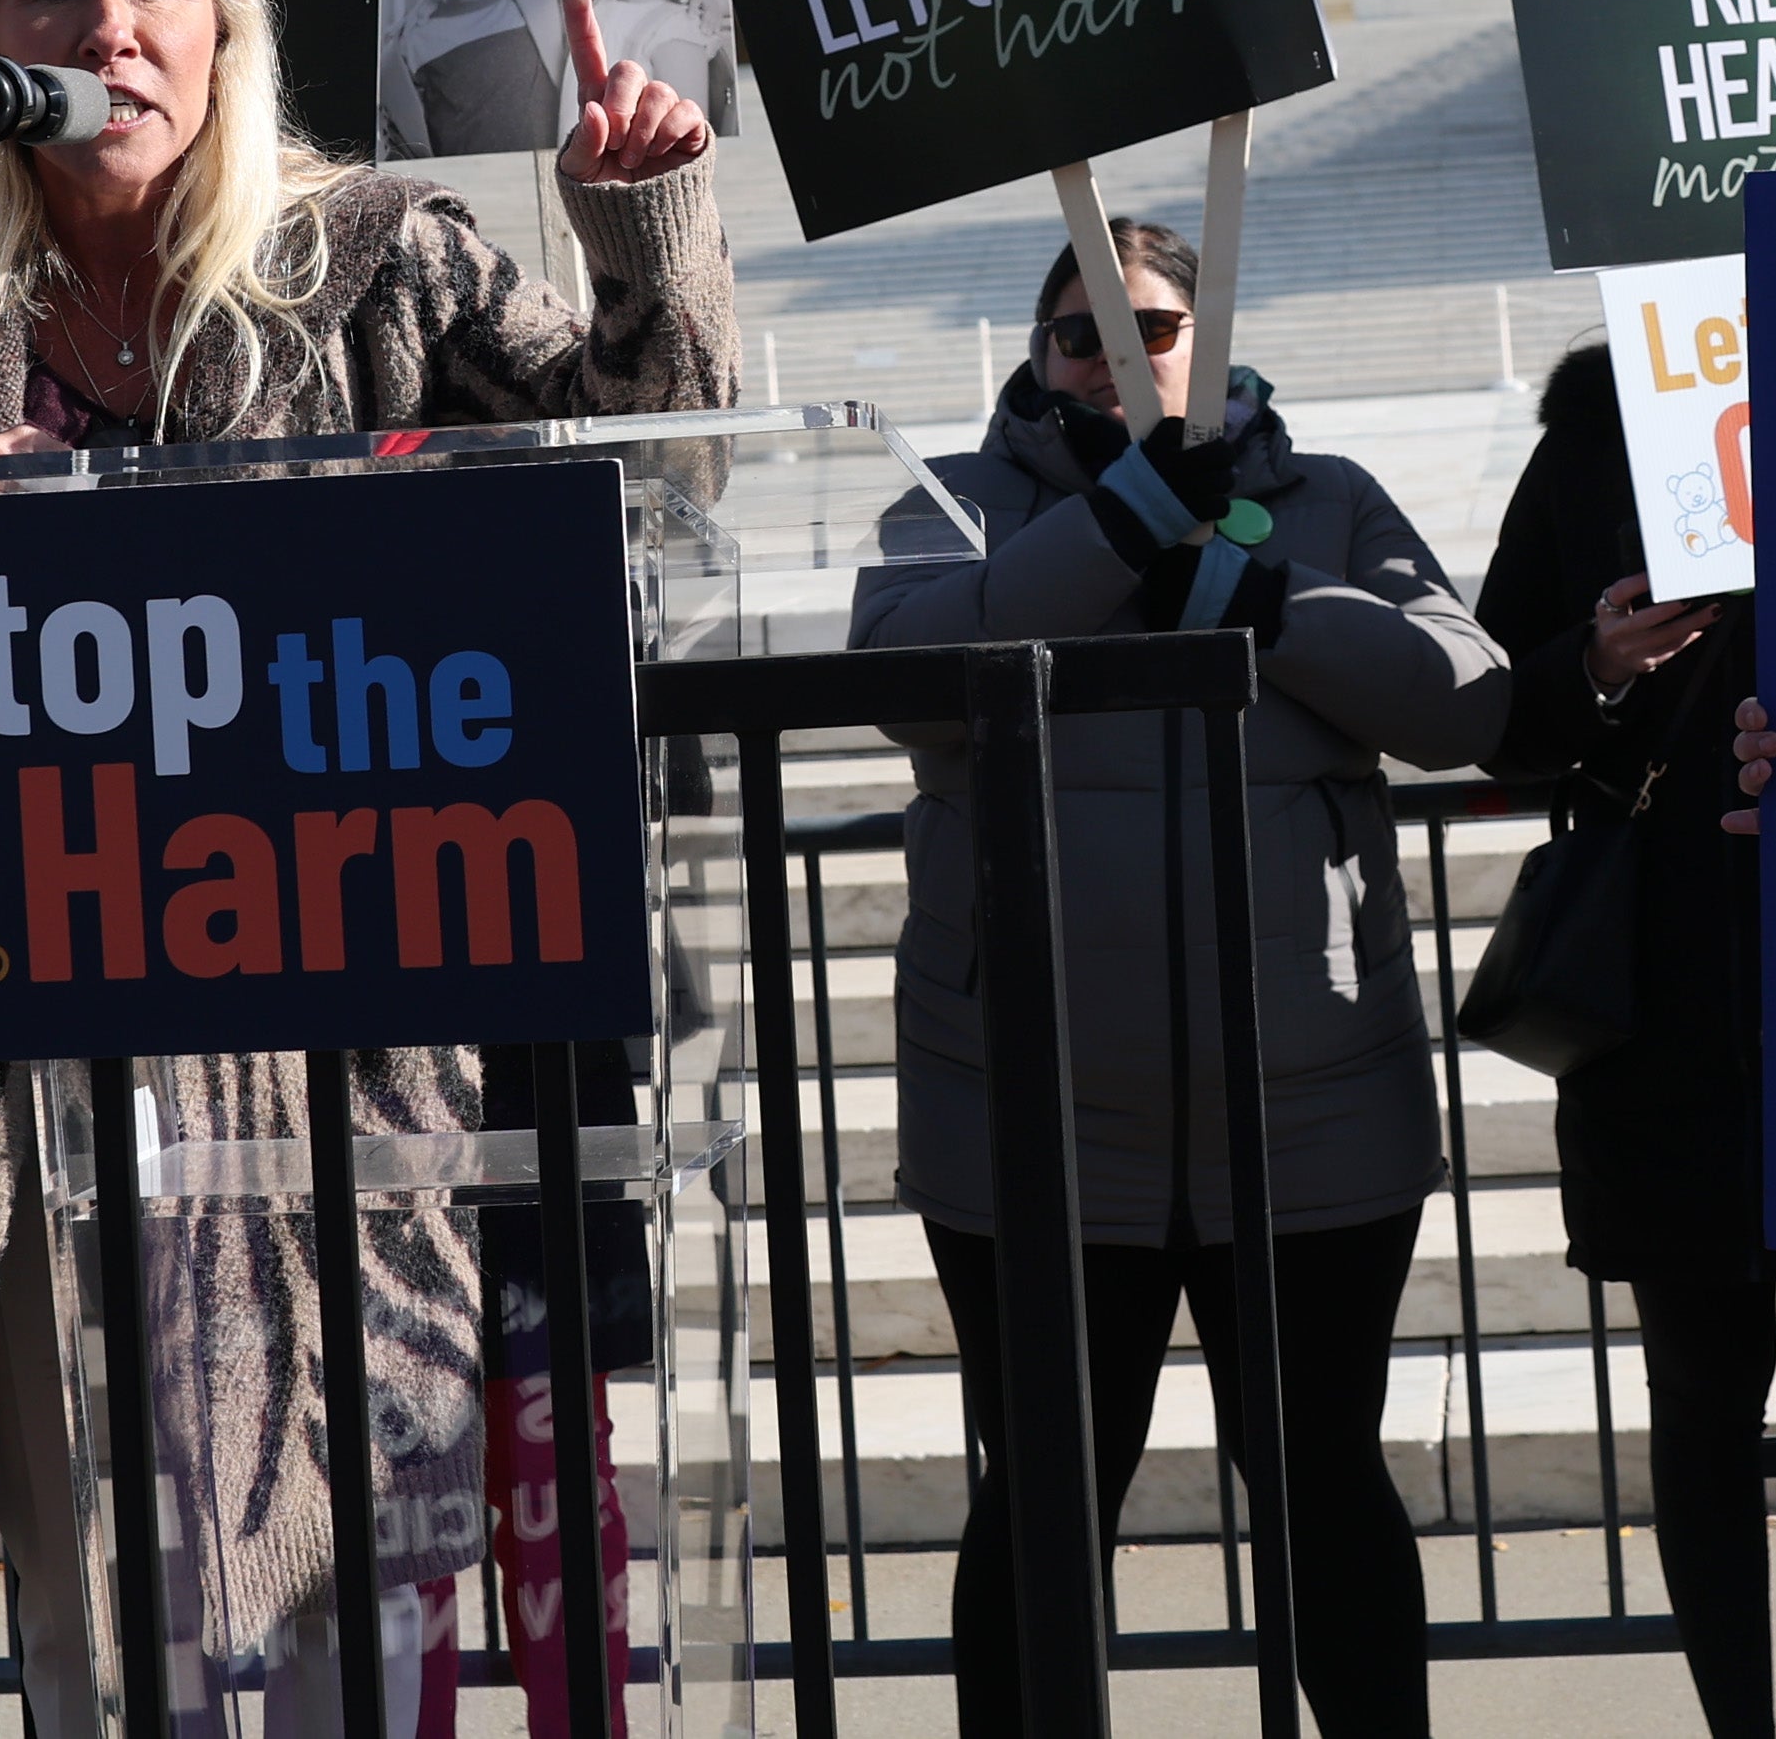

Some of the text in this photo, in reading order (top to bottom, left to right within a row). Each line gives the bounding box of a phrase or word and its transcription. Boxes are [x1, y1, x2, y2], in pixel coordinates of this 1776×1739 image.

[1640, 298, 1750, 393] Le
[268, 616, 513, 774] the
[18, 761, 584, 983] Harm
